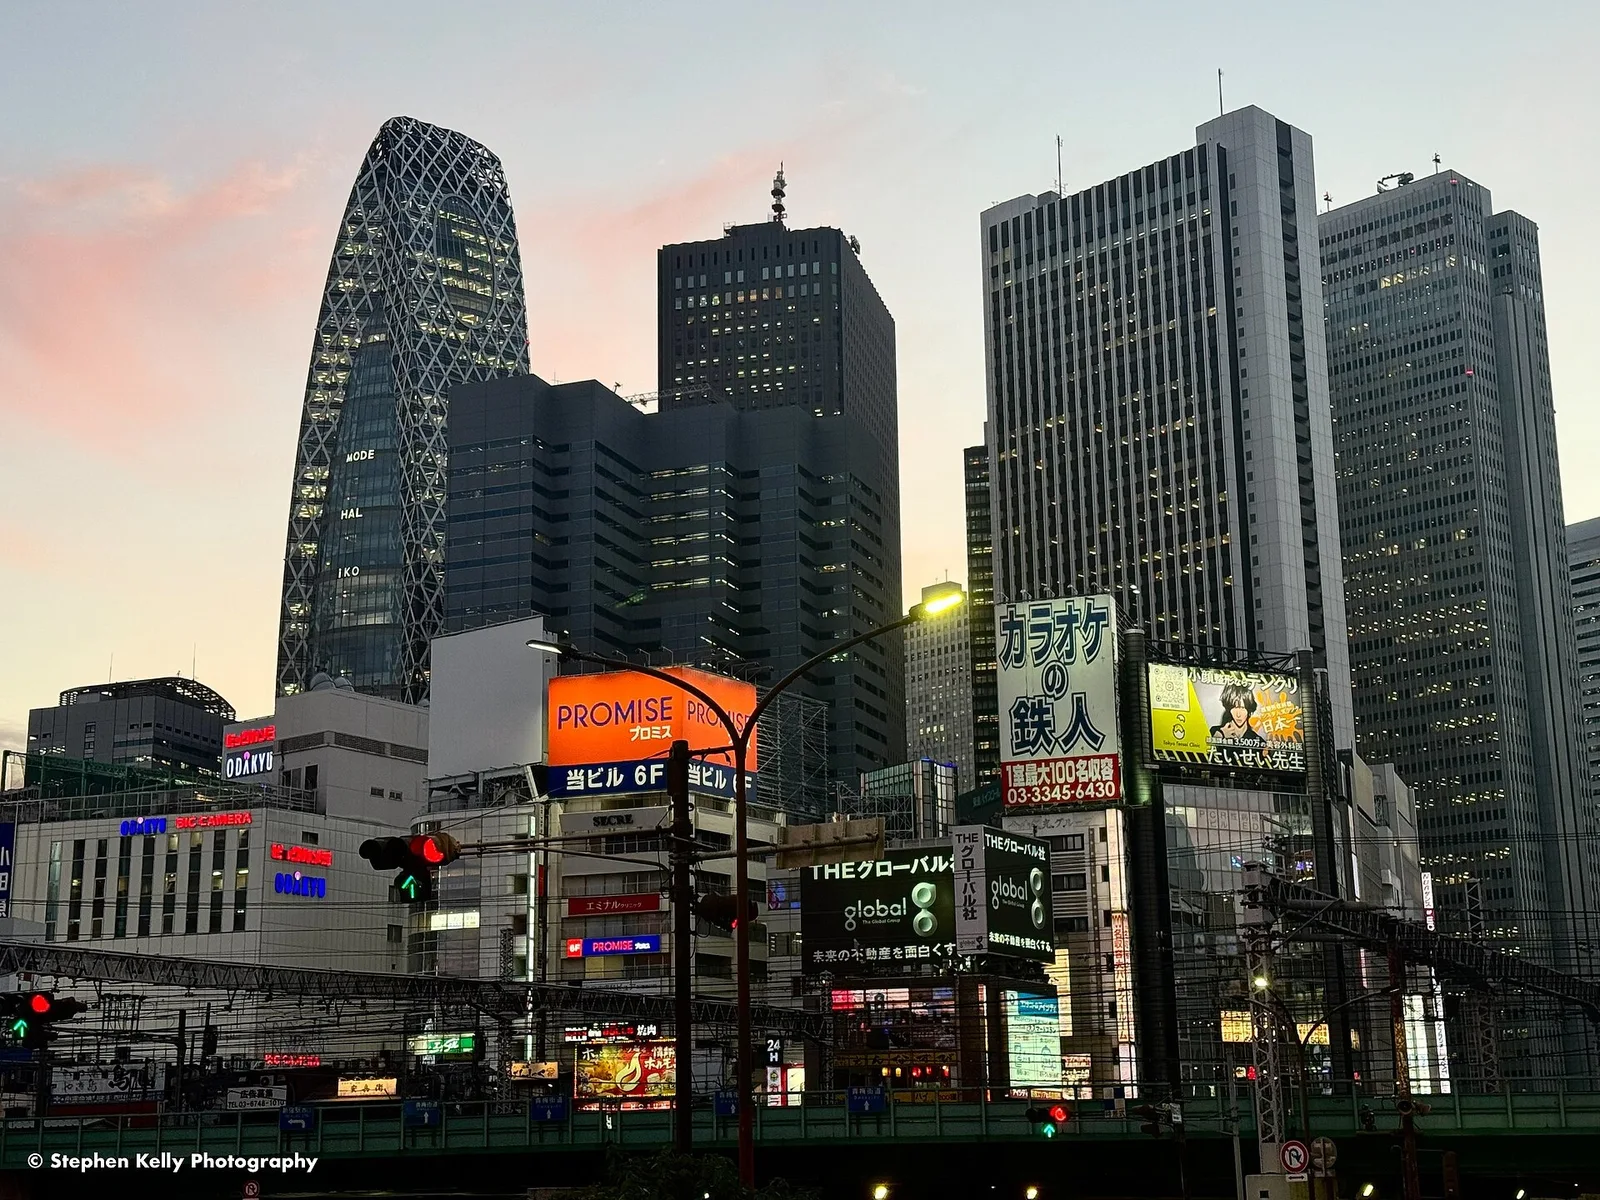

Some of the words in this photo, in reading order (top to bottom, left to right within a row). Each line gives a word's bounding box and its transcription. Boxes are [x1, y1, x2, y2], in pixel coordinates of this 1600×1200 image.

[346, 449, 375, 463] MODE
[340, 507, 363, 520] HAL
[338, 566, 360, 579] IKO
[999, 597, 1109, 671] カラオケ
[1042, 660, 1069, 699] の
[557, 696, 673, 730] PROMISE
[686, 700, 751, 733] PROIS
[1262, 714, 1302, 734] 日本一
[629, 725, 673, 742] プロミス
[1008, 692, 1106, 757] 鉄人
[226, 751, 273, 778] ODAKYU
[1207, 745, 1306, 770] たいせい先生
[566, 767, 624, 791] 当ビル
[634, 763, 665, 786] 6F
[688, 763, 727, 790] 当ビル
[1006, 757, 1114, 788] 1室最大100名収容
[1007, 781, 1116, 804] 03-3345-6430
[120, 817, 167, 836] ODAKYU
[176, 815, 198, 829] BIC
[199, 811, 252, 827] CAMERA
[593, 814, 634, 827] SECRE
[985, 833, 1046, 861] THEグローバル社
[275, 870, 327, 899] ODAKYU
[991, 875, 1028, 910] global
[844, 897, 907, 931] global
[592, 940, 634, 952] PROMISE
[813, 942, 957, 963] 未来の不動産を面白くす
[637, 1024, 658, 1036] 焼肉
[767, 1039, 781, 1052] 24
[644, 1057, 677, 1070] ホルモ
[769, 1052, 779, 1062] H
[228, 1101, 238, 1109] TEL
